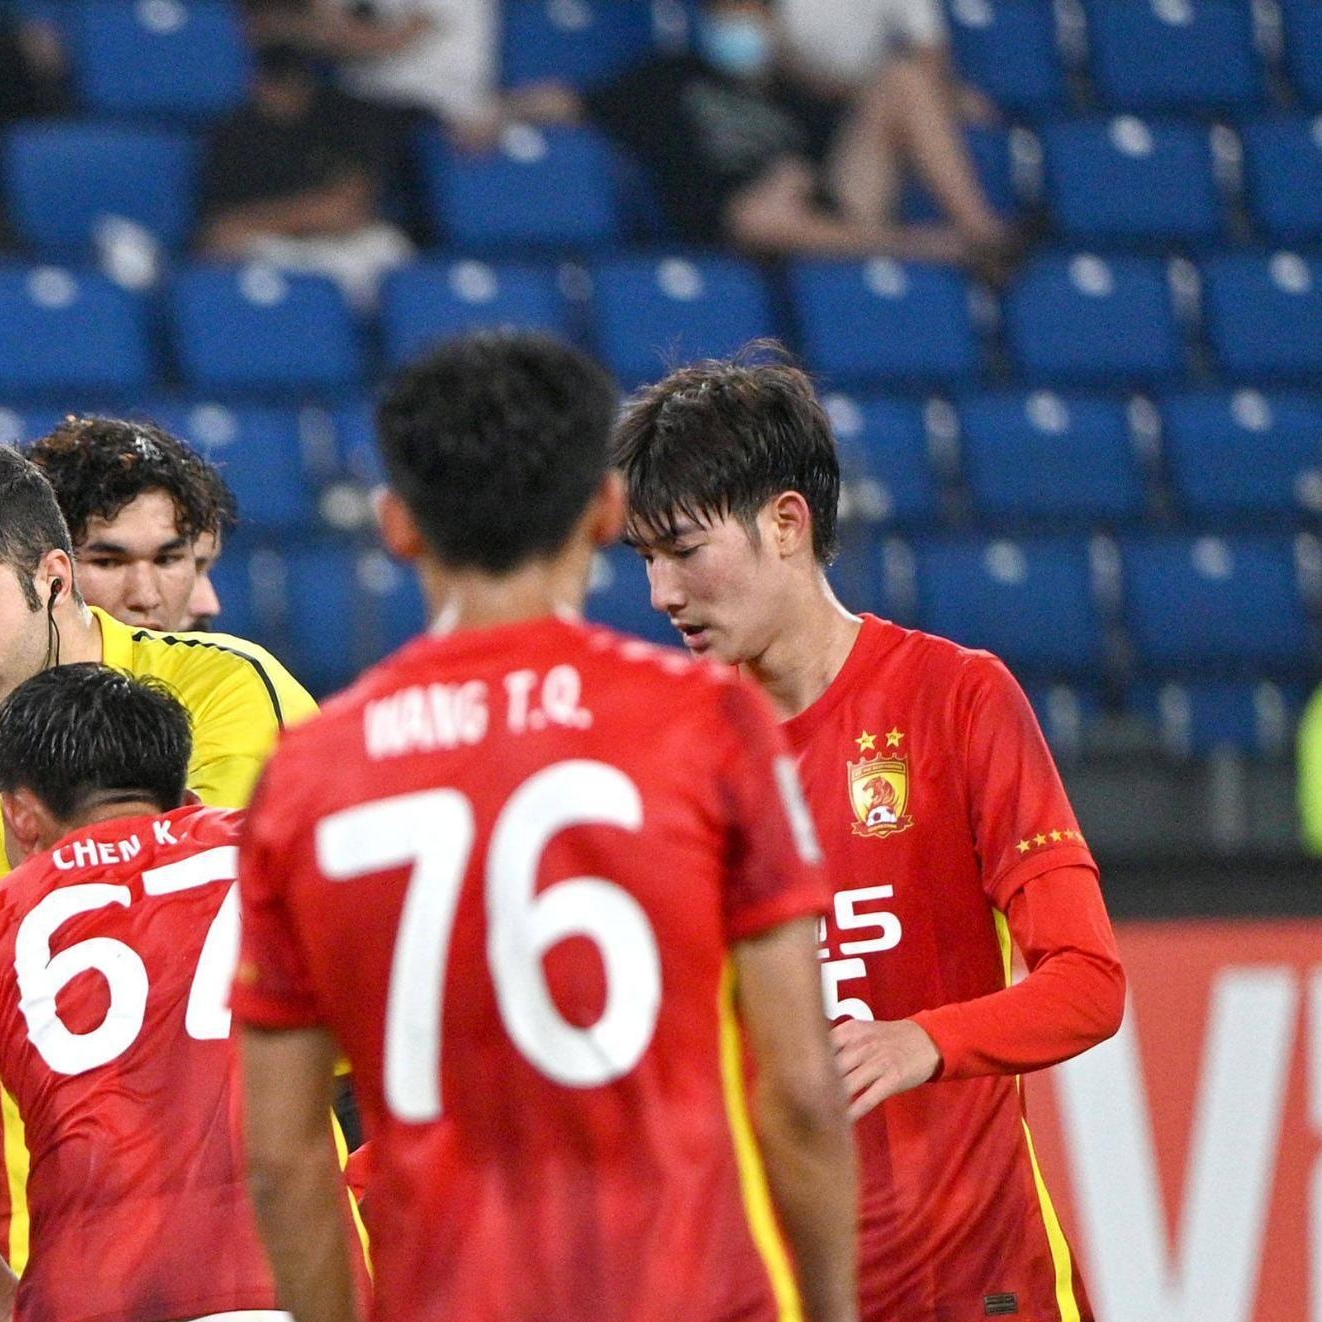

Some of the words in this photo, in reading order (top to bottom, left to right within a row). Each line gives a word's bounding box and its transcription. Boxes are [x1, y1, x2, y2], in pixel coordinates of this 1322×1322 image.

[14, 845, 240, 1076] 67
[53, 835, 141, 870] CHEN
[152, 820, 188, 845] K.
[315, 758, 663, 1125] 76
